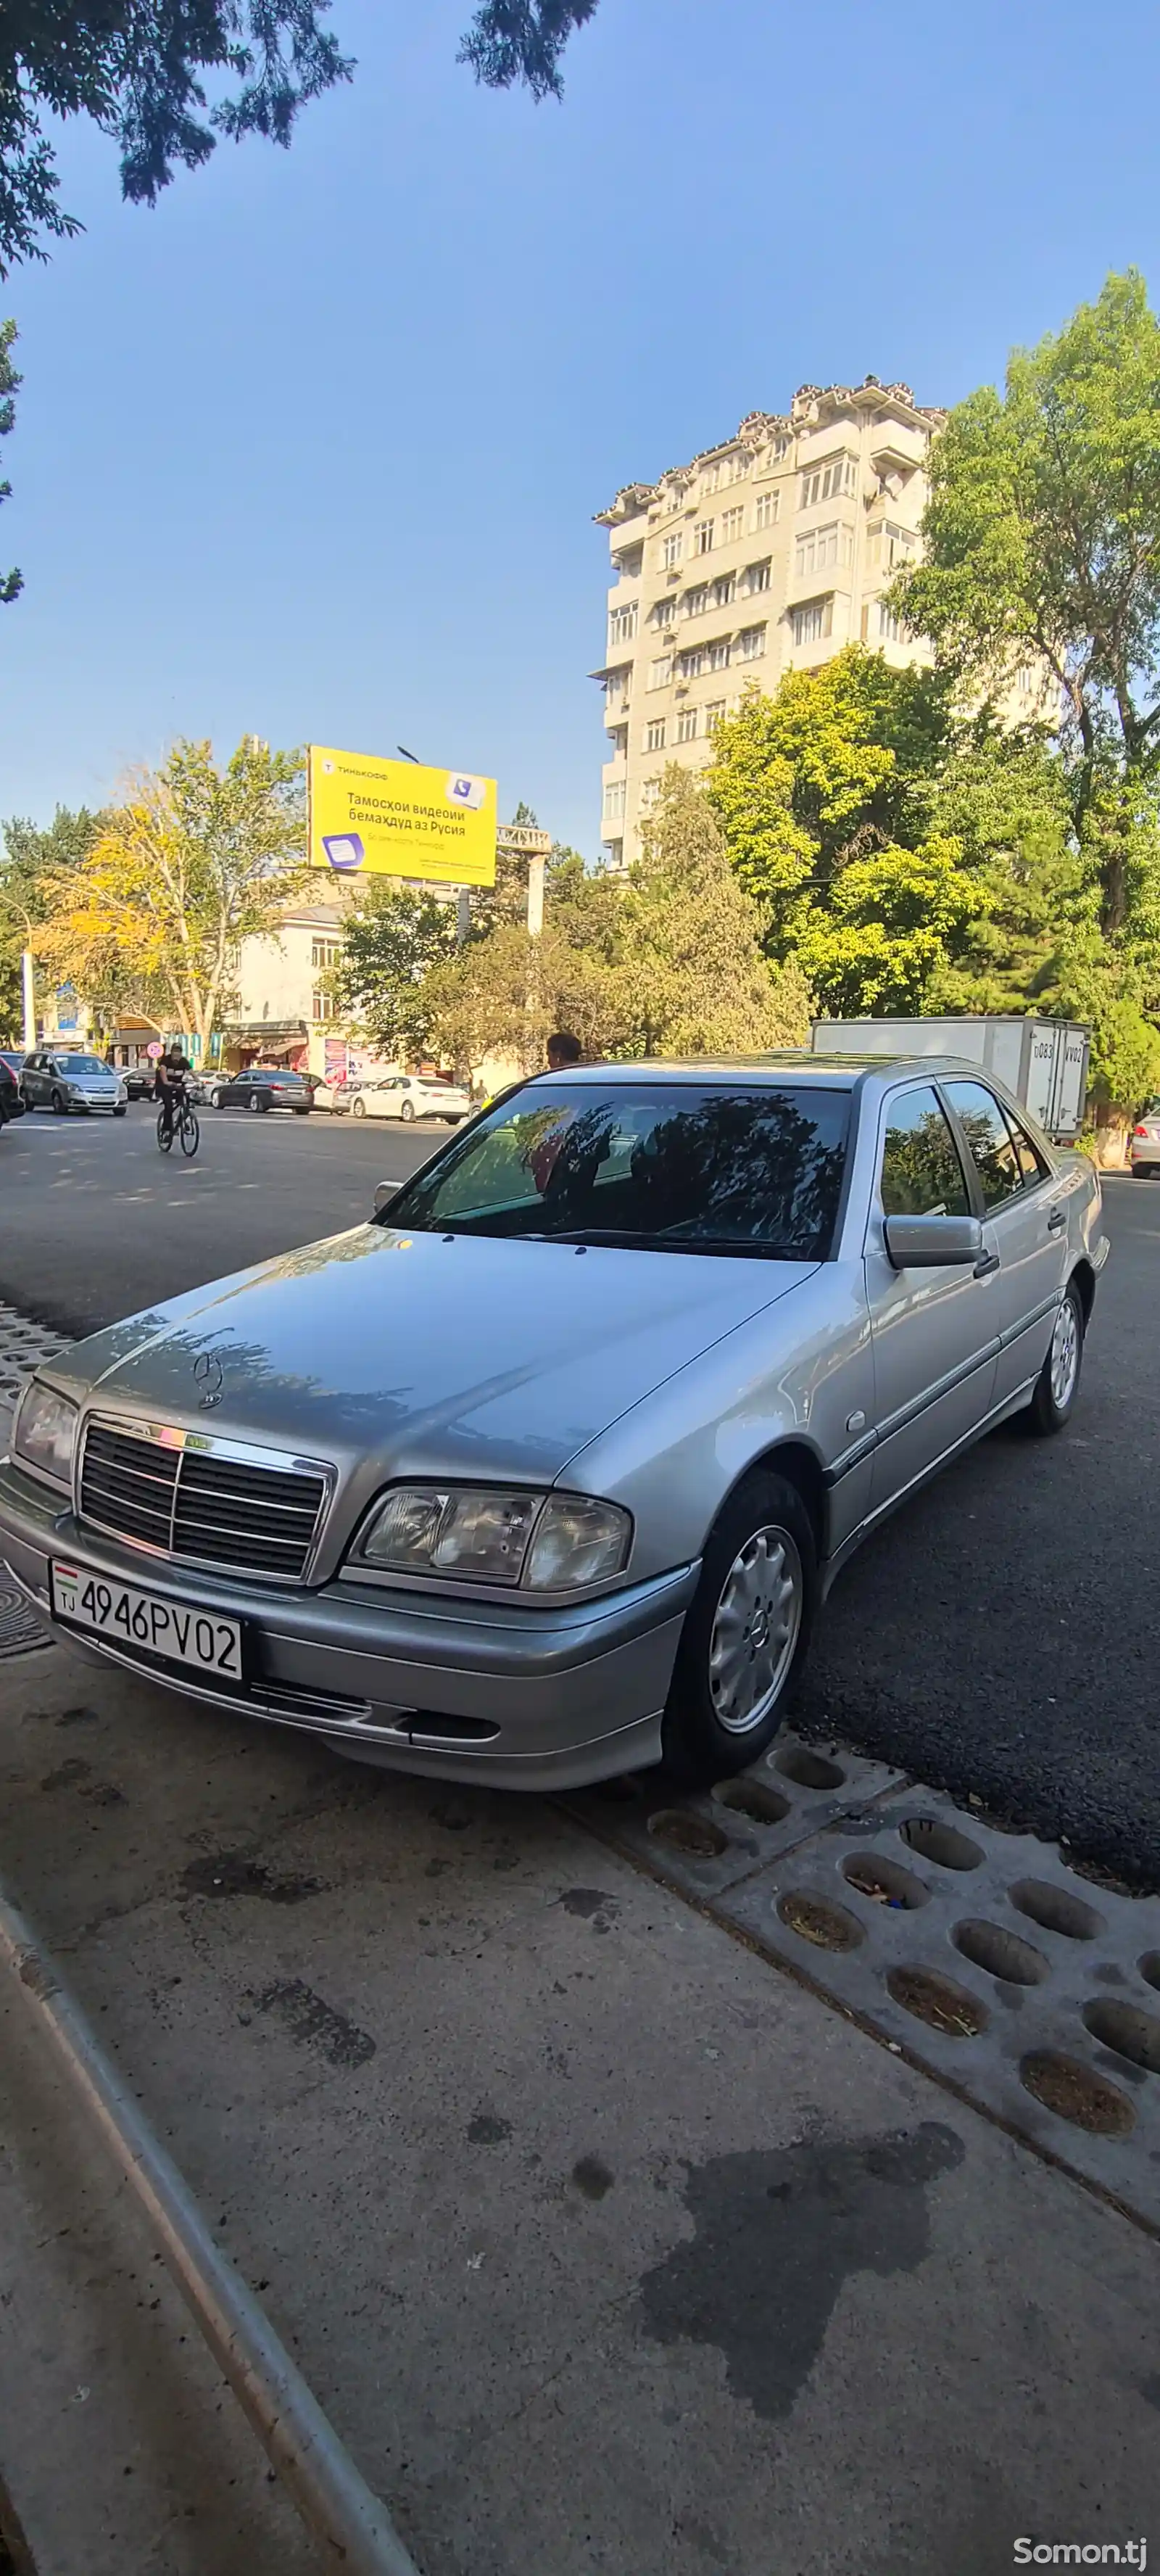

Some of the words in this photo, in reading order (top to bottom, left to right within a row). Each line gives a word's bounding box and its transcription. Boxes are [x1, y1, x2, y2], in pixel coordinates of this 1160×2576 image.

[347, 792, 410, 813] Тамосҳои
[413, 804, 465, 822] видеоии
[415, 820, 428, 831] аз
[431, 821, 465, 836] Русия
[61, 1592, 75, 1612] TJ
[81, 1580, 237, 1672] 4946PV02
